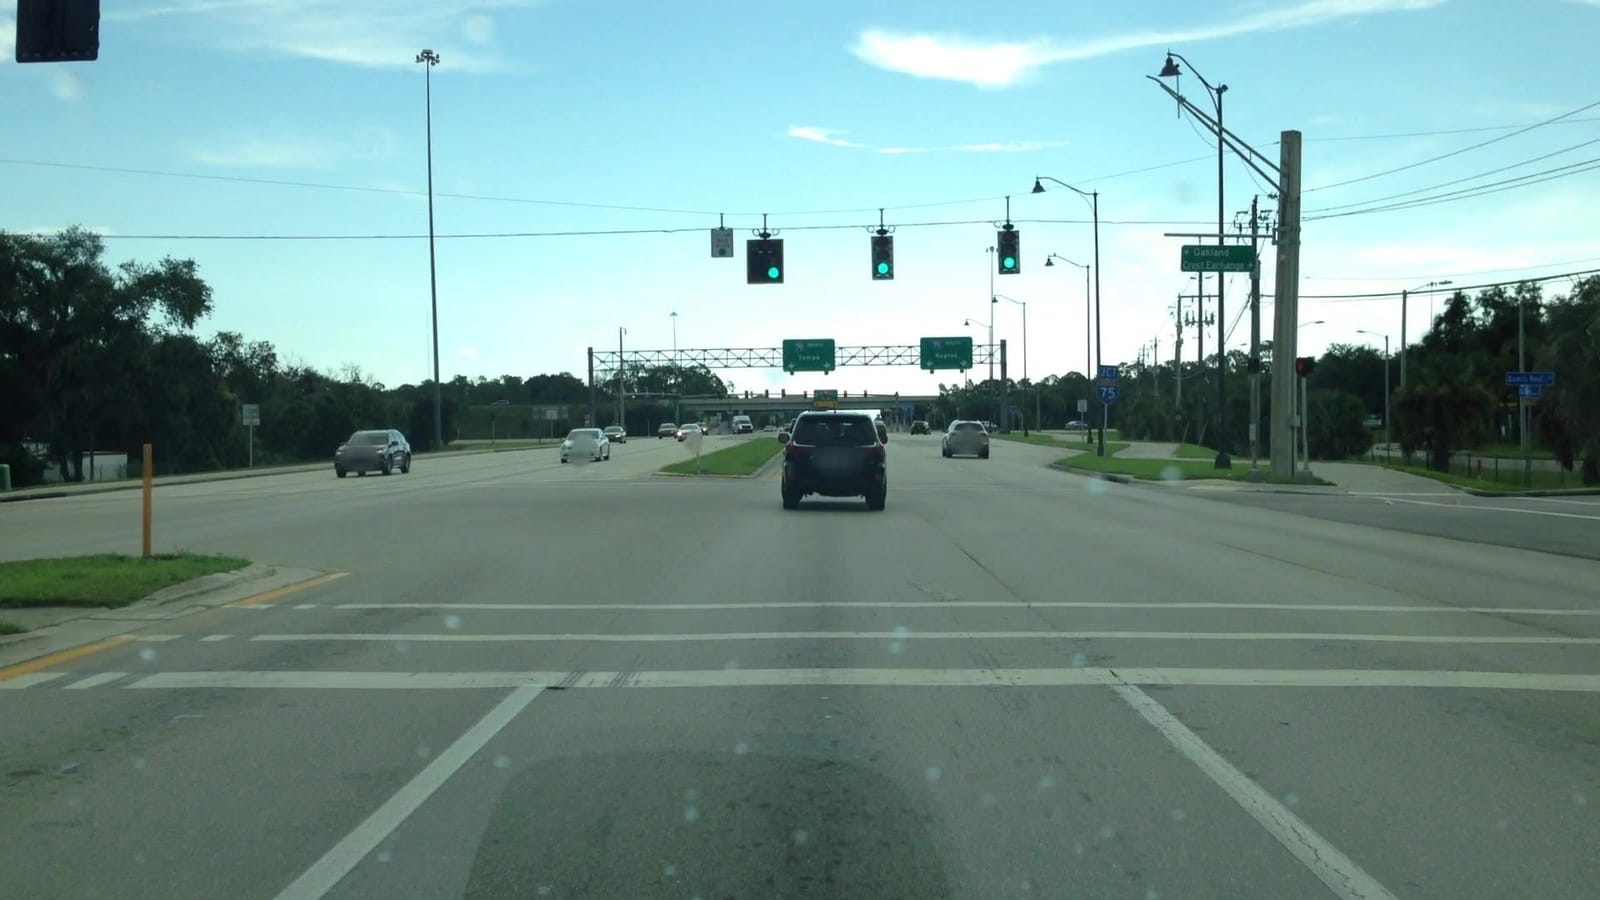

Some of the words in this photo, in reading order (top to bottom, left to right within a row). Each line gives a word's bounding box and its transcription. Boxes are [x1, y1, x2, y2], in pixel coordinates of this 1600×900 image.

[1193, 247, 1230, 257] Oakland
[1183, 261, 1204, 270] Crest
[1206, 261, 1245, 271] Exchange
[1101, 367, 1116, 377] JCT
[1100, 387, 1116, 399] 75
